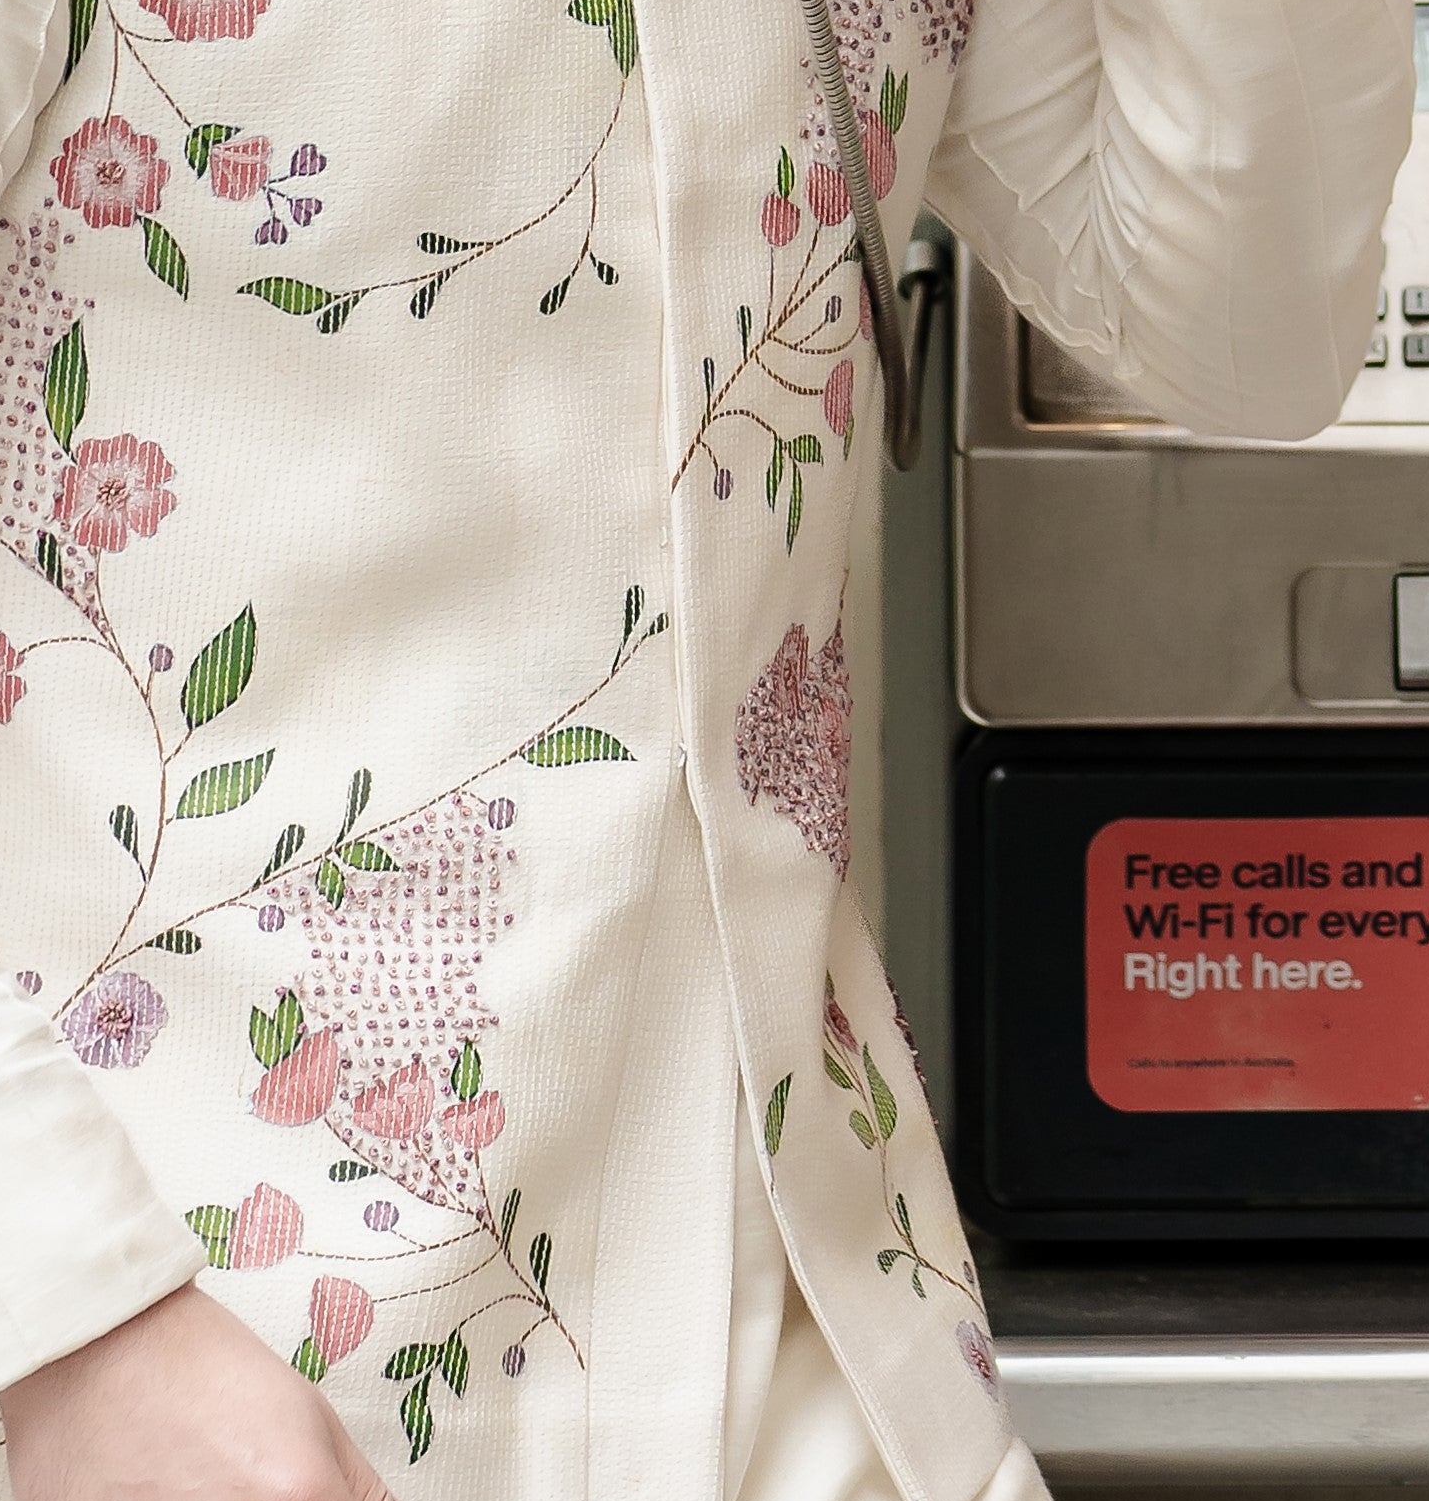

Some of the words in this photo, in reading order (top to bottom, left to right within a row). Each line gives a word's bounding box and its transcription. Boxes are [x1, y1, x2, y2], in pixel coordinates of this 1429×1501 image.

[1124, 854, 1222, 890] Free
[1231, 852, 1332, 889] calls
[1341, 852, 1424, 888] and
[1124, 902, 1235, 939] Wi-Fi
[1244, 902, 1308, 938] for
[1123, 951, 1243, 1000] Right
[1251, 950, 1364, 991] here.
